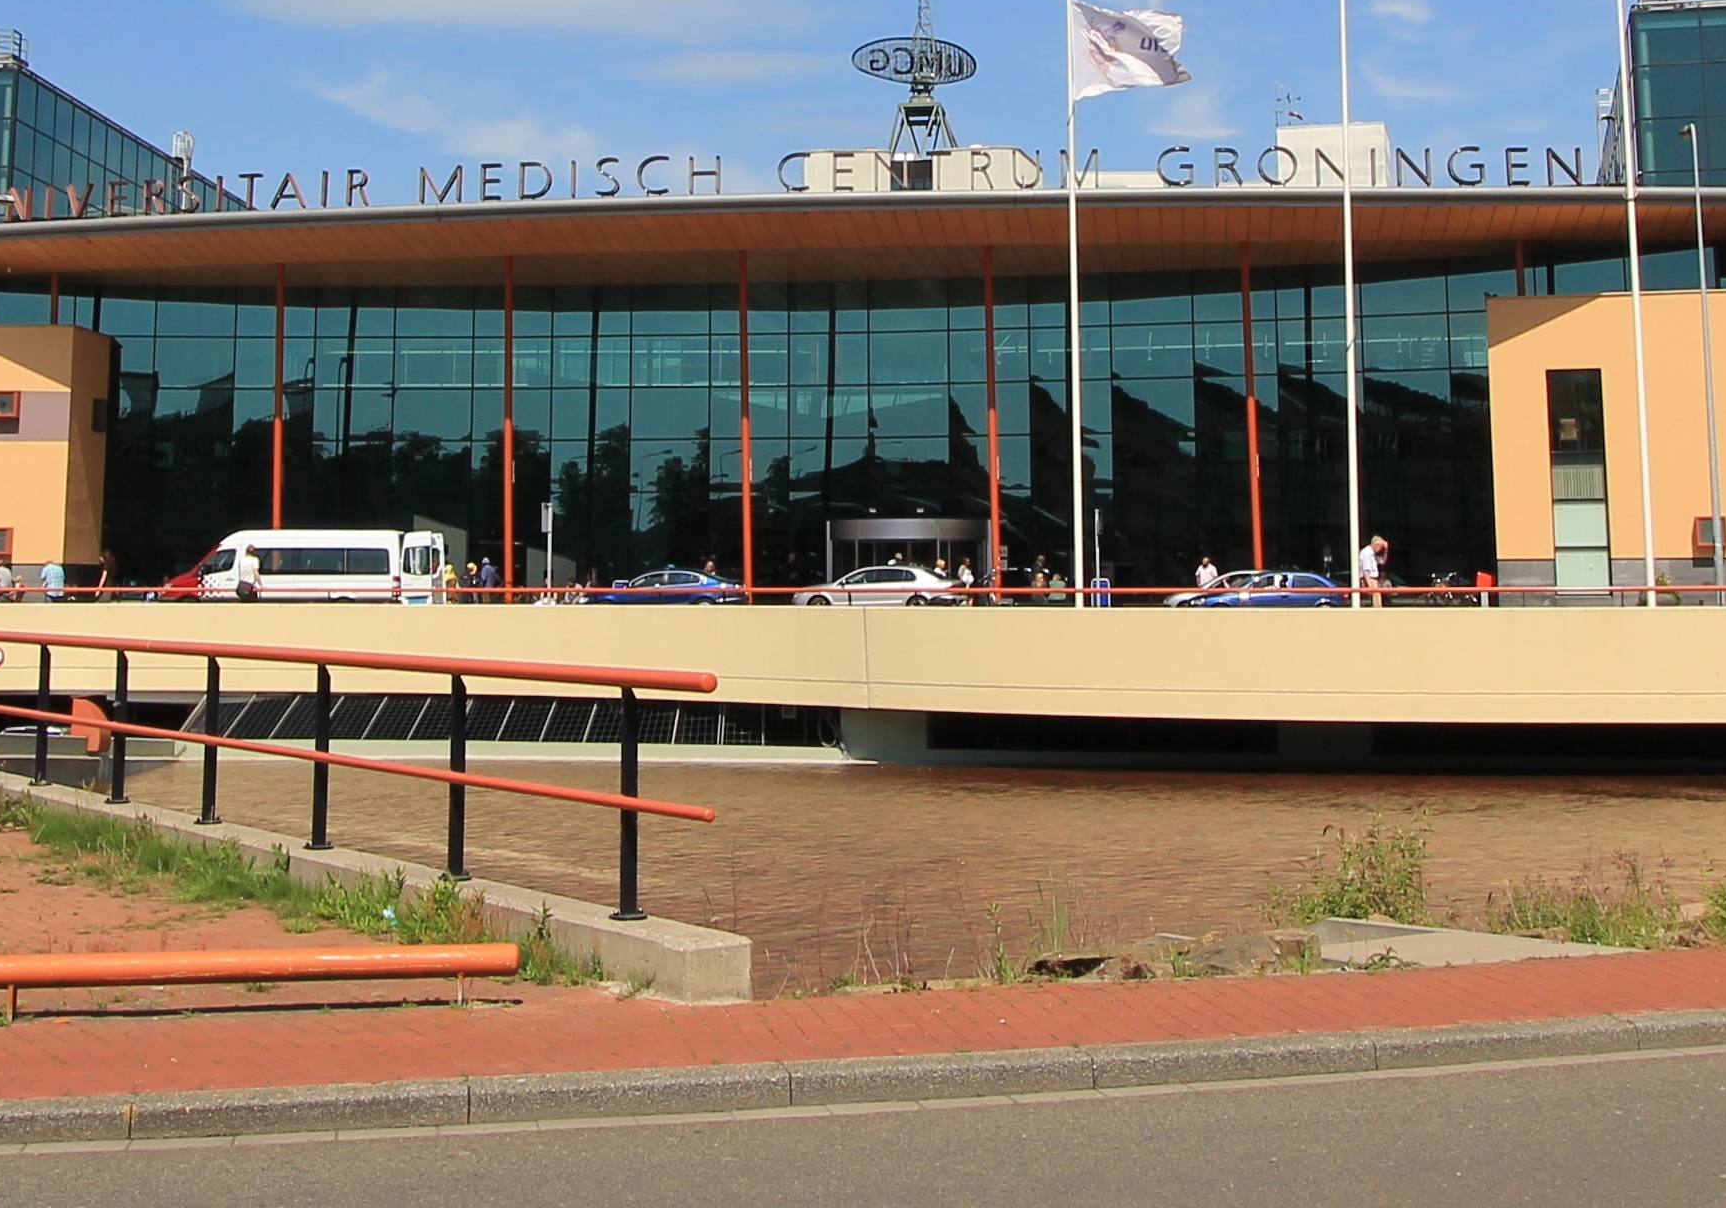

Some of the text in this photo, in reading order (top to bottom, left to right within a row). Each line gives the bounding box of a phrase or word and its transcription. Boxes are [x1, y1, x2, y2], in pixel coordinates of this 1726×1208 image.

[419, 154, 722, 204] MEDISCH
[777, 148, 1099, 192] CENTRUM
[1156, 145, 1582, 187] GRONINGEN
